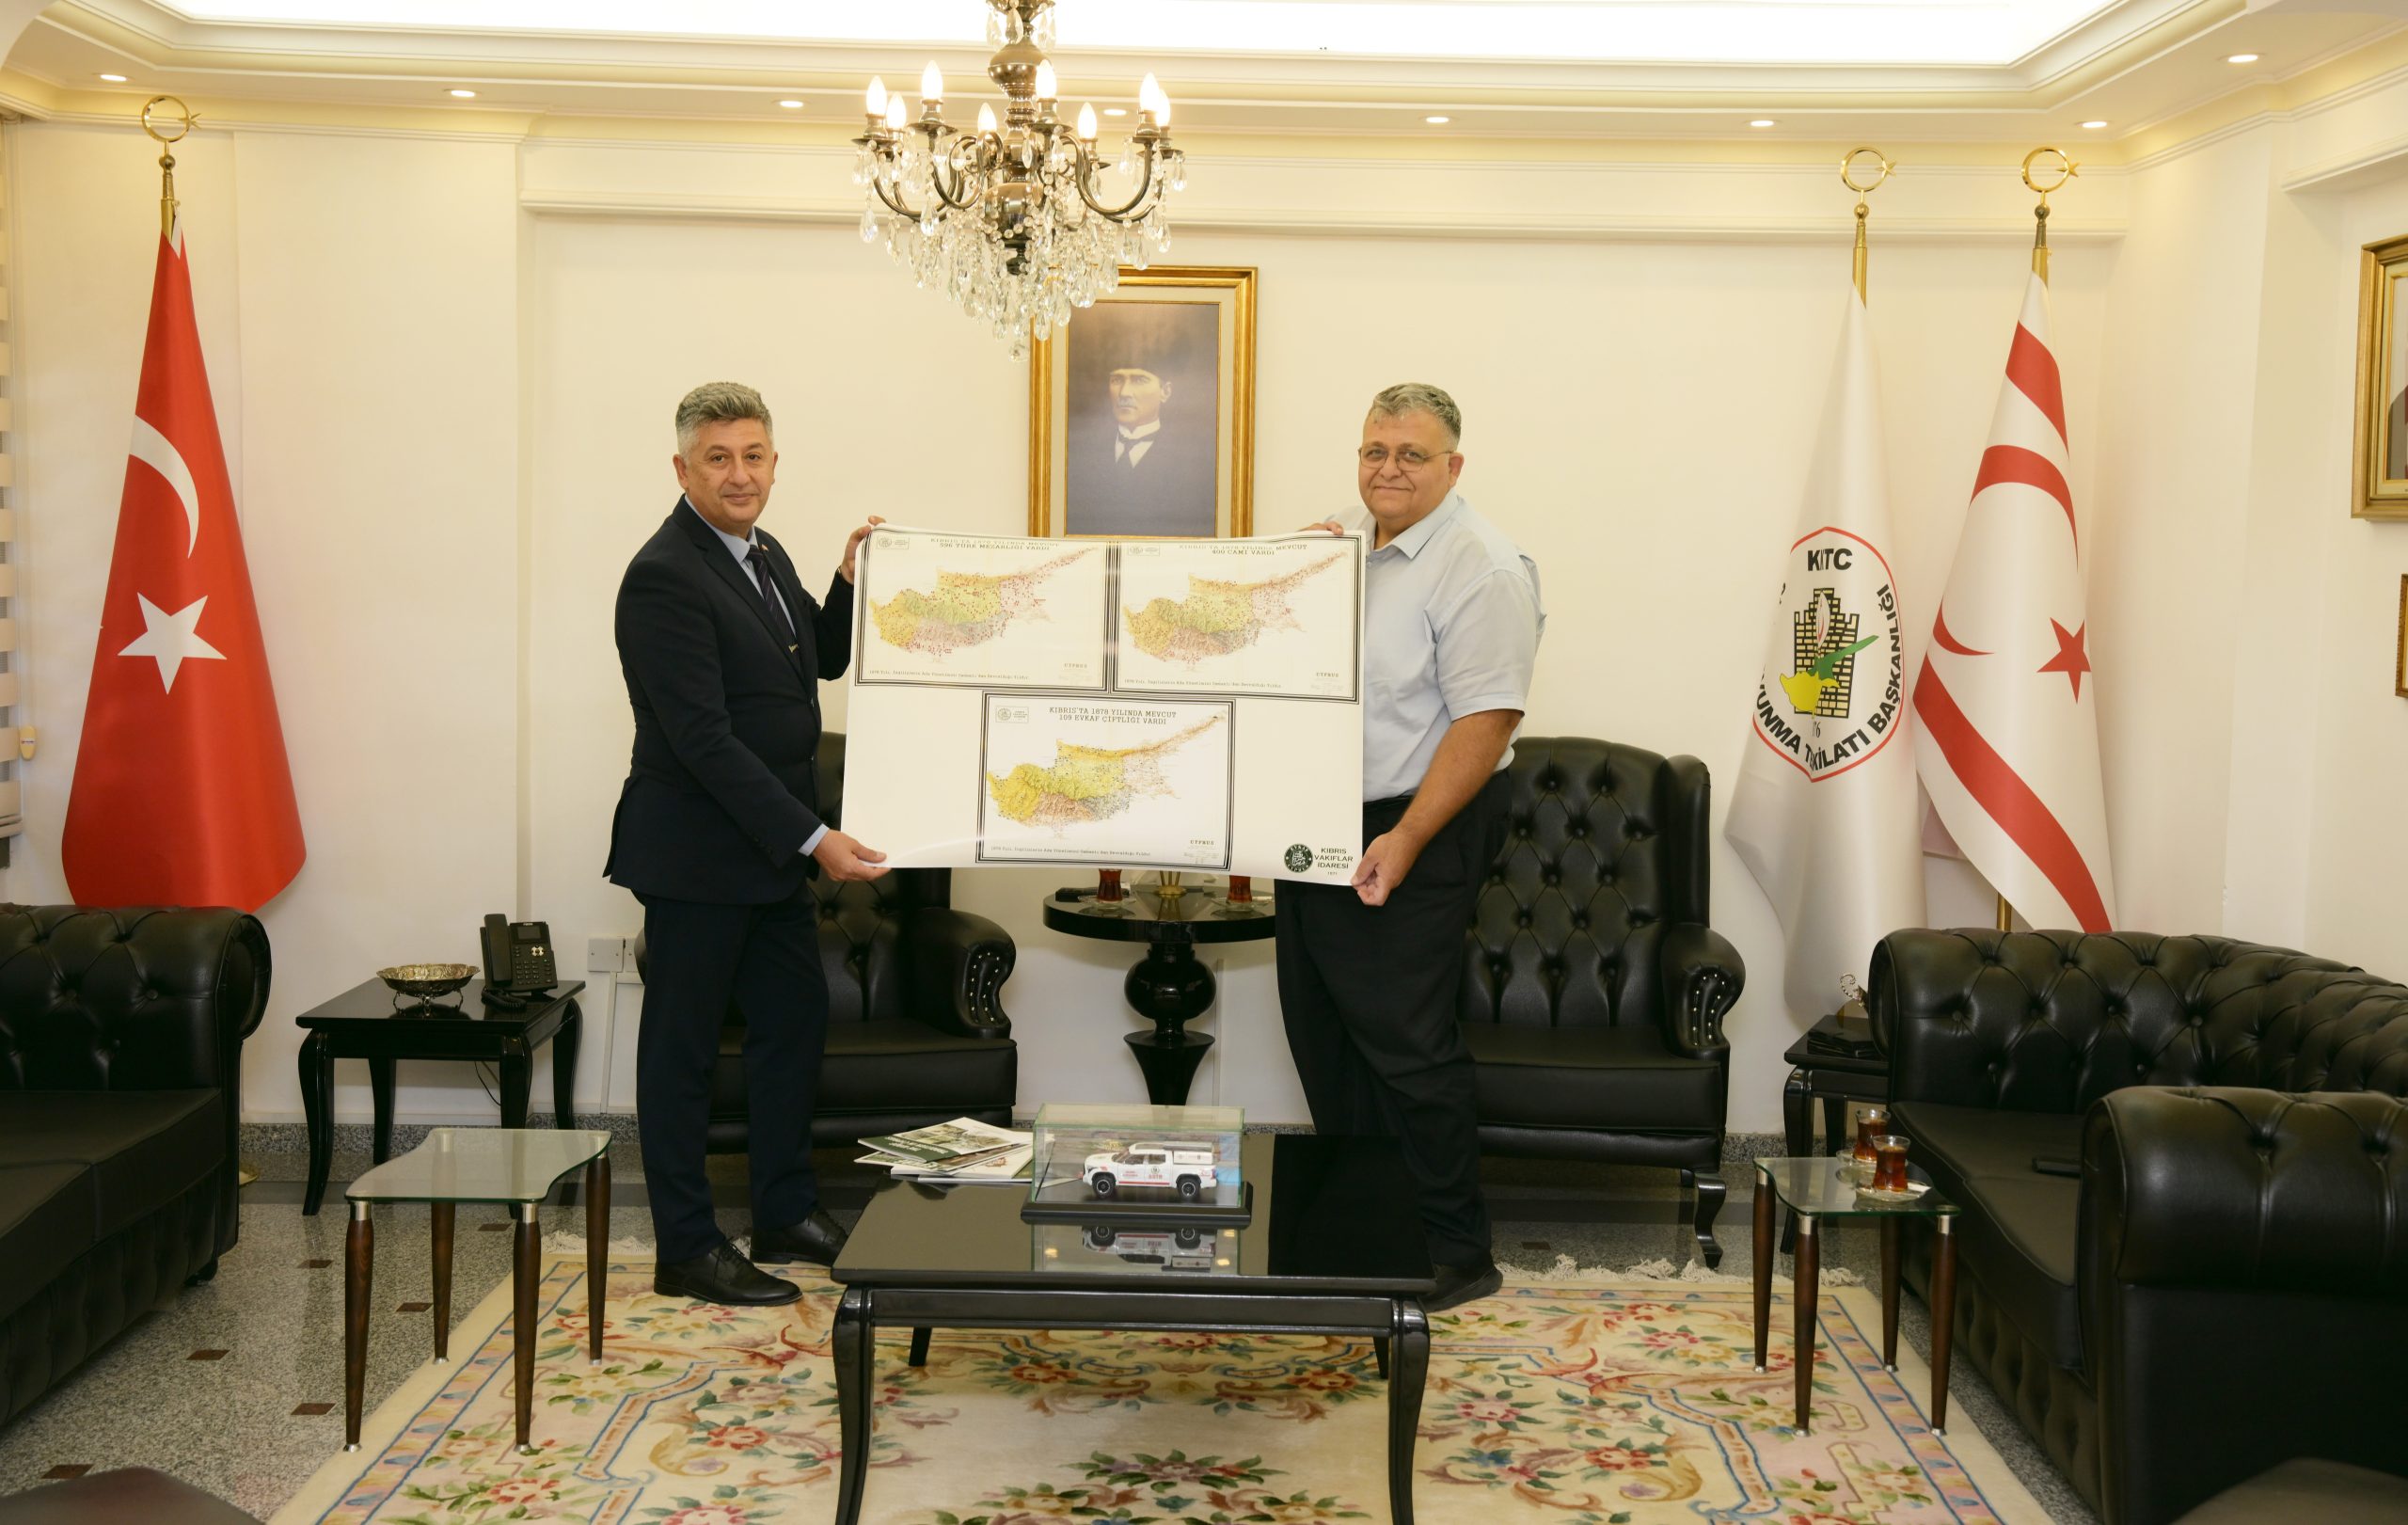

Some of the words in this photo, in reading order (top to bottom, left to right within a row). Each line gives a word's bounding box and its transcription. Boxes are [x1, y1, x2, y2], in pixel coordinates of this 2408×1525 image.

[1866, 583, 1902, 735] BAŞKANLIĞI
[1049, 707, 1088, 715] KIBRIS'TA
[1091, 707, 1109, 716] 1878
[1111, 708, 1143, 717] YILINDA
[1145, 710, 1177, 719] MEVCUT
[1074, 714, 1100, 723] EVKAF
[1143, 717, 1166, 725] VARDI
[1314, 854, 1354, 863] VAKIFLAR
